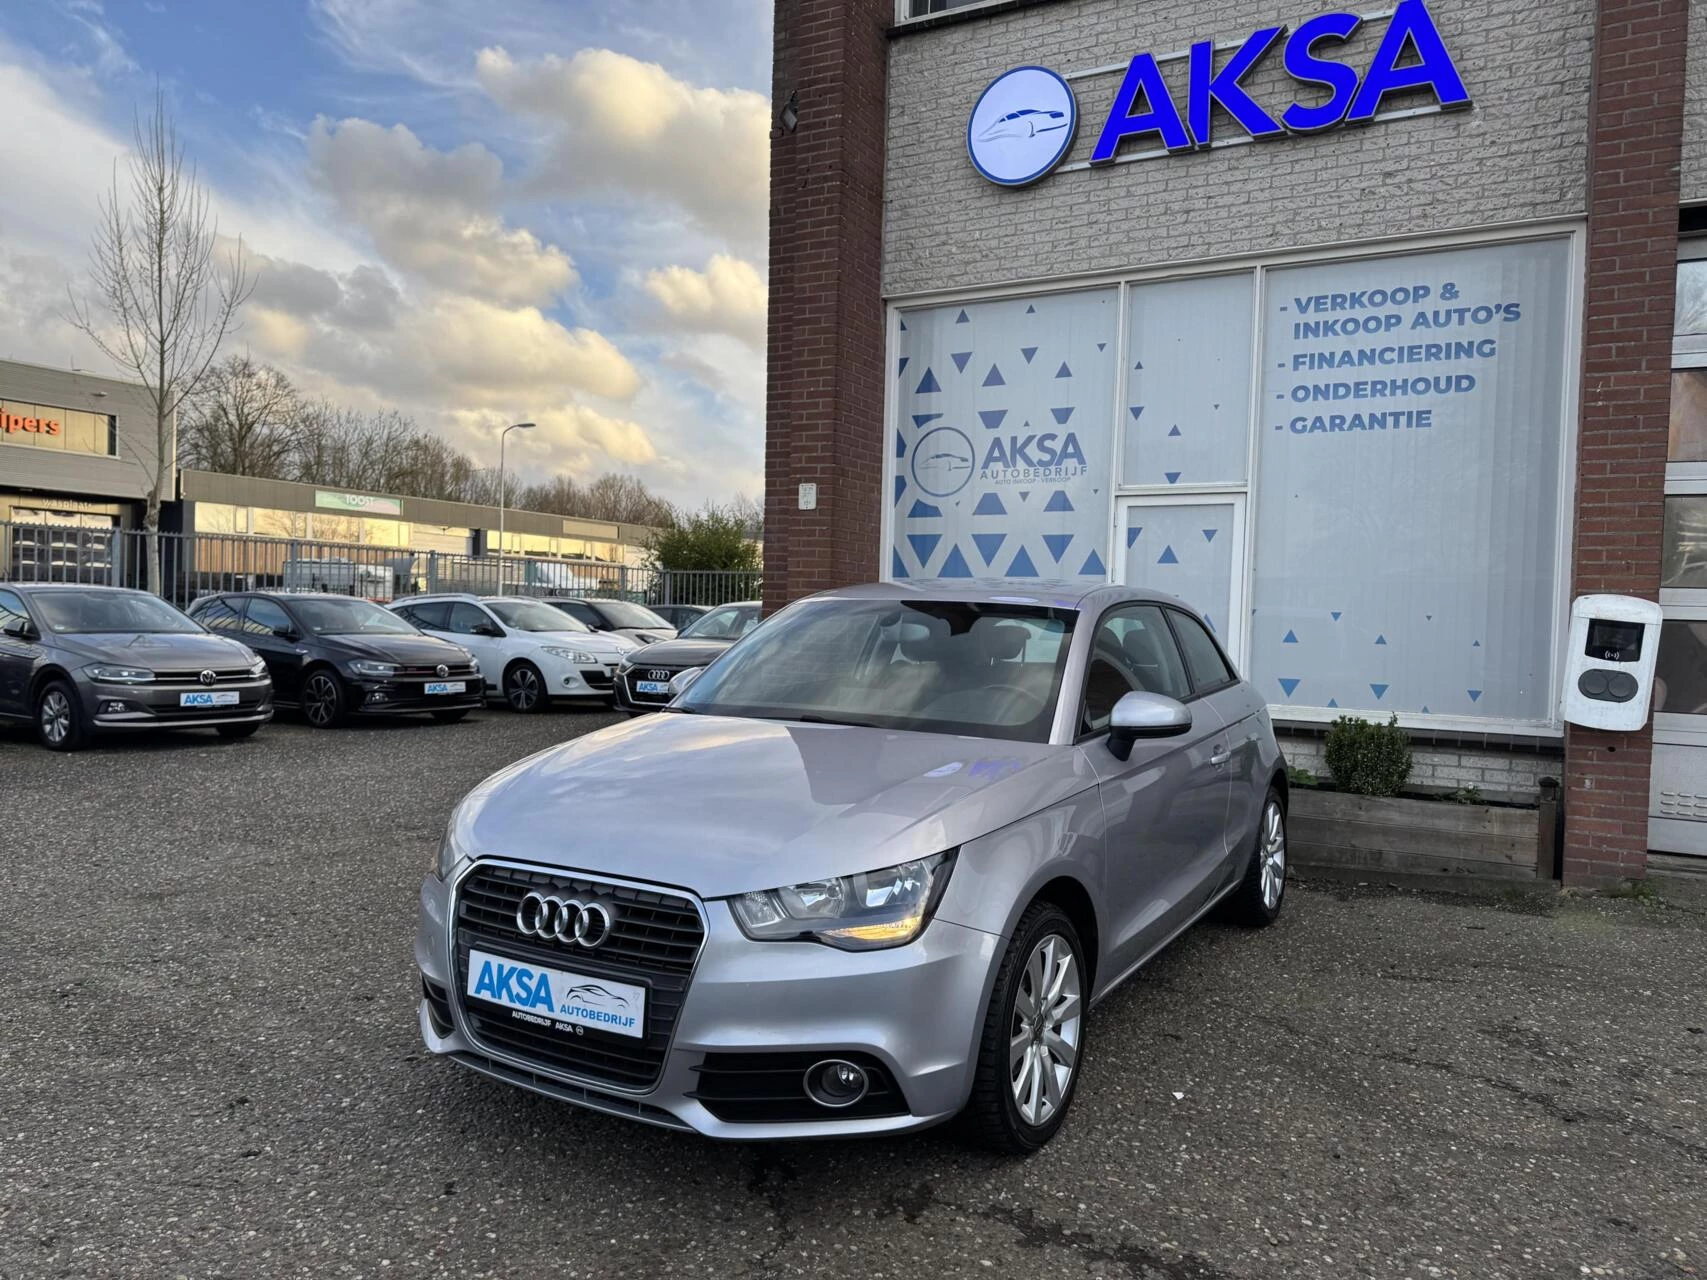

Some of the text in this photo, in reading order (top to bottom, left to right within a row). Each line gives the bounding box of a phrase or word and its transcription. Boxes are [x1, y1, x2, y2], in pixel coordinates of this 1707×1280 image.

[1089, 0, 1472, 167] AKSA
[1294, 284, 1431, 315] VERKOOP
[1439, 282, 1460, 302] &
[1293, 302, 1522, 341] INKOOP AUTO'S
[1292, 338, 1497, 372] FINANCIERING
[1291, 374, 1477, 403] ONDERHOUD
[1289, 409, 1433, 435] GARANTIE
[980, 432, 1087, 470] AKSA
[979, 466, 1088, 481] AUTOBEDRIJF
[345, 494, 375, 506] TOOST
[184, 693, 214, 705] AKSA
[474, 960, 555, 1014] AKSA
[511, 1010, 574, 1033] AUTOBEDRIJF AKSA
[560, 1003, 636, 1028] AUTOBEDRIJF
